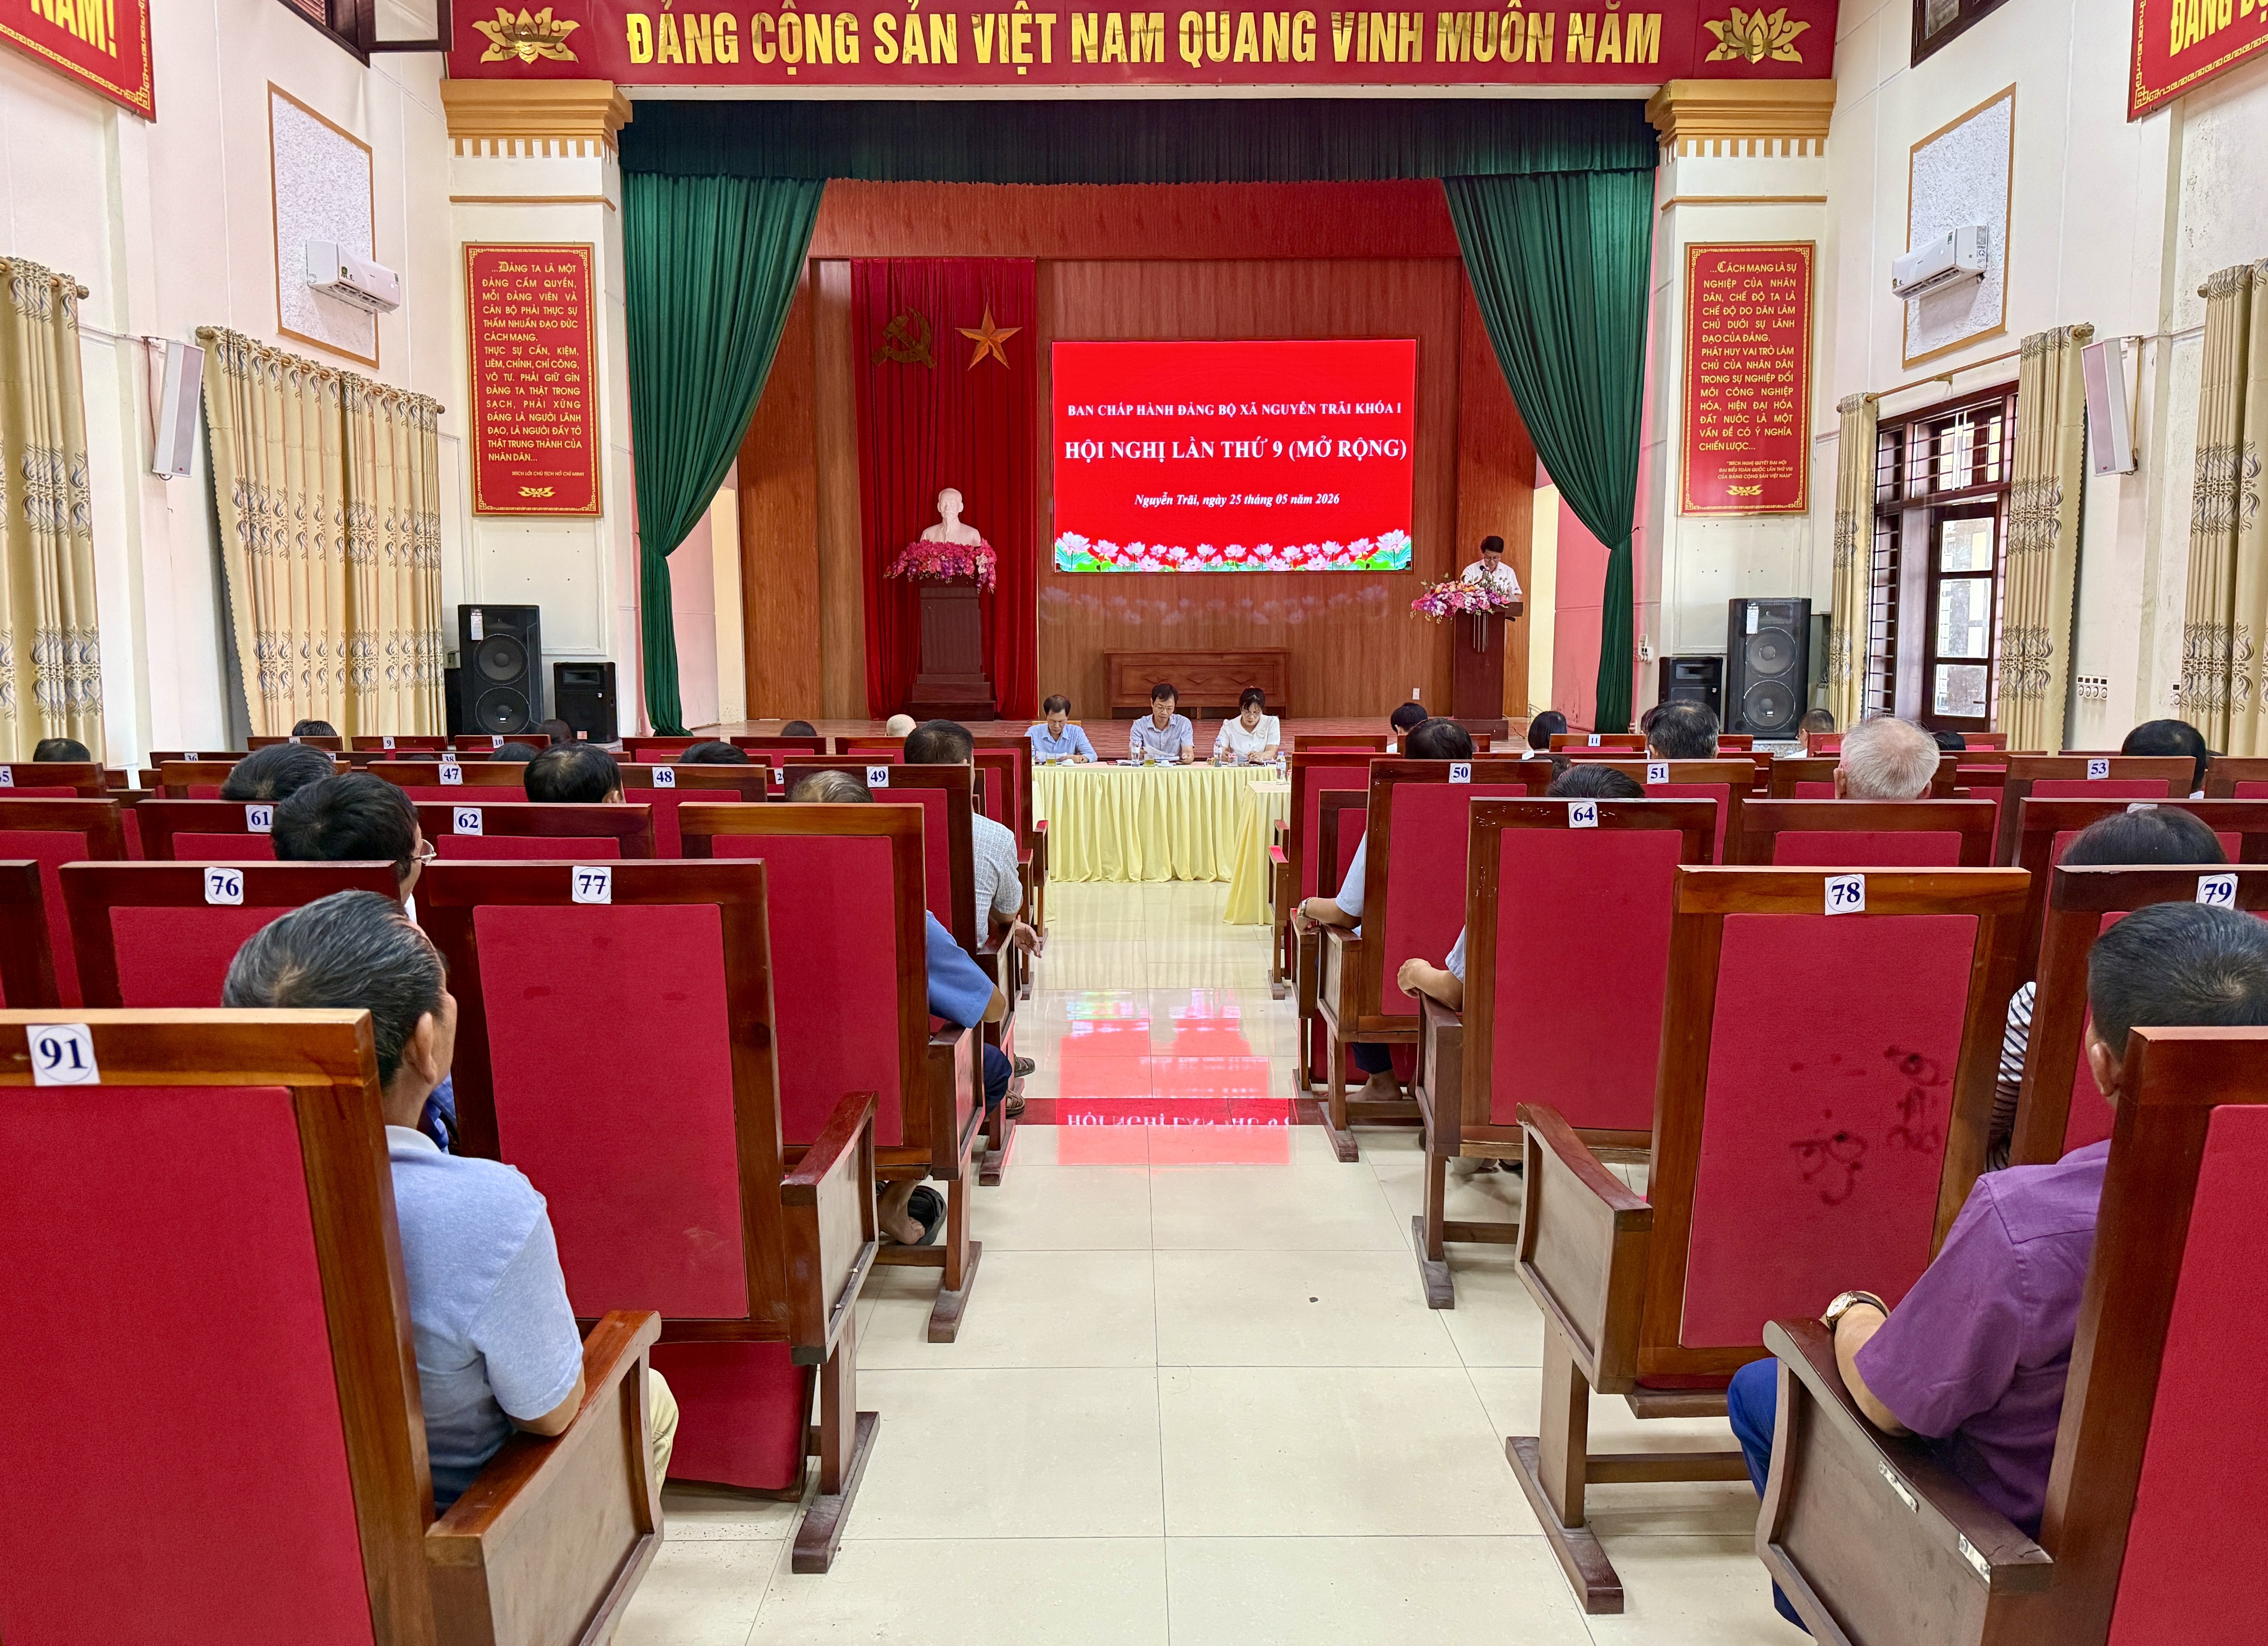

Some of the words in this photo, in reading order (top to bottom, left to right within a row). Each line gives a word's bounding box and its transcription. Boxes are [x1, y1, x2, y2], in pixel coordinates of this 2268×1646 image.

[752, 0, 859, 75] CỘNG
[874, 0, 957, 64] SẢN
[971, 0, 1056, 75] VIỆT
[1072, 13, 1164, 63] NAM
[1179, 11, 1316, 68] QUANG
[1331, 12, 1423, 62] VINH
[1436, 0, 1555, 62] MUÔN
[1566, 0, 1661, 63] NĂM
[531, 265, 541, 273] TA
[545, 262, 555, 273] LÀ
[558, 263, 576, 275] MỘT
[1747, 264, 1774, 273] MẠNG
[1775, 261, 1785, 272] LÀ
[1786, 263, 1797, 273] SỰ
[1704, 278, 1737, 290] NGHIỆP
[1743, 277, 1763, 288] CỦA
[1770, 277, 1796, 287] NHÂN
[506, 290, 532, 301] ĐẢNG
[538, 291, 558, 301] VIÊN
[564, 291, 577, 301] VÀ
[1703, 292, 1724, 303] DÂN,
[1729, 290, 1747, 301] CHẾ
[1751, 291, 1765, 303] ĐỘ
[1786, 290, 1796, 301] LÀ
[483, 303, 501, 314] CÁN
[505, 304, 517, 316] BỘ
[521, 304, 539, 314] PHẢI
[543, 306, 564, 316] THỰC
[568, 306, 577, 316] SỰ
[1702, 304, 1721, 316] CHẾ
[1723, 305, 1736, 317] ĐỘ
[1739, 307, 1753, 315] DO
[1756, 305, 1774, 314] DÂN
[1778, 304, 1795, 314] LÀM
[1702, 318, 1720, 329] CHỦ
[1727, 318, 1749, 329] DƯỚI
[1755, 320, 1766, 330] SỰ
[1773, 318, 1795, 328] LÃNH
[484, 331, 508, 341] CÁCH
[509, 333, 538, 343] MẠNG.
[1702, 334, 1722, 344] ĐẠO
[1723, 331, 1741, 342] CỦA
[1742, 331, 1770, 342] ĐẢNG.
[484, 346, 506, 356] THỰC
[512, 346, 522, 356] SỰ
[557, 345, 579, 357] KIỆM,
[1702, 346, 1723, 356] PHÁT
[1724, 348, 1741, 356] HUY
[1742, 347, 1757, 355] VAI
[1759, 345, 1775, 355] TRÒ
[1777, 345, 1794, 355] LÀM
[485, 358, 505, 369] LIÊM,
[506, 358, 534, 369] CHÍNH,
[535, 358, 550, 368] CHÍ
[551, 359, 579, 370] CÔNG,
[1701, 359, 1719, 370] CHỦ
[1723, 359, 1742, 370] CỦA
[1746, 359, 1771, 369] NHÂN
[1775, 359, 1794, 368] DÂN
[485, 371, 498, 381] VÔ
[521, 371, 538, 381] PHẢI
[564, 372, 580, 382] GÌN
[1701, 375, 1730, 383] TRONG
[1732, 374, 1743, 385] SỰ
[1745, 372, 1775, 384] NGHIỆP
[486, 384, 511, 395] ĐẢNG
[515, 387, 525, 395] TA
[529, 385, 548, 396] THẬT
[552, 387, 581, 395] TRONG
[1700, 387, 1718, 397] MỚI
[1725, 387, 1754, 396] CÔNG
[1761, 385, 1794, 397] NGHIỆP
[487, 400, 515, 409] SẠCH,
[523, 398, 545, 408] PHẢI
[553, 398, 581, 409] XỨNG
[1068, 405, 1093, 416] BAN
[1137, 402, 1173, 415] HÀNH
[1178, 402, 1214, 415] ĐẢNG
[1219, 403, 1236, 417] BỘ
[1240, 402, 1258, 415] XÃ
[1355, 400, 1394, 414] KHÓA
[1397, 402, 1401, 413] I
[1700, 400, 1721, 411] HÓA,
[1728, 400, 1747, 411] HIỆN
[1753, 401, 1768, 411] ĐẠI
[1774, 398, 1793, 409] HÓA
[487, 411, 512, 421] ĐÁNG
[515, 411, 526, 421] LÀ
[529, 411, 556, 422] NGƯỜI
[560, 412, 581, 422] LÃNH
[1699, 413, 1717, 424] ĐẤT
[1723, 413, 1749, 424] NƯỚC
[1757, 413, 1767, 423] LÀ
[1774, 413, 1793, 424] MỘT
[487, 438, 506, 450] THẬT
[508, 440, 534, 448] TRUNG
[535, 438, 562, 448] THÀNH
[564, 438, 582, 449] CỦA
[1065, 439, 1104, 463] HỘI
[1111, 441, 1165, 463] NGHỊ
[1221, 436, 1268, 458] THỨ
[1273, 441, 1283, 458] 9
[1289, 435, 1332, 462] (MỞ
[1338, 437, 1406, 461] RỘNG)
[1726, 442, 1755, 452] LƯỢC...
[488, 452, 512, 461] NHÂN
[513, 452, 537, 461] DÂN...
[1177, 494, 1200, 506] Trãi,
[1202, 494, 1227, 508] ngày
[1229, 494, 1242, 505] 25
[1244, 494, 1273, 507] tháng
[1275, 494, 1288, 504] 05
[1290, 494, 1313, 504] năm
[1315, 493, 1340, 504] 2026
[444, 768, 459, 780] 47
[1453, 767, 1468, 778] 50
[1650, 767, 1665, 779] 51
[2091, 762, 2106, 775] 53
[0, 770, 9, 782] 5
[656, 771, 672, 782] 48
[870, 770, 886, 782] 49
[251, 811, 271, 826] 61
[458, 813, 478, 828] 62
[1573, 807, 1594, 822] 64
[211, 876, 239, 896] 76
[579, 874, 606, 895] 77
[1831, 882, 1860, 905] 78
[2203, 883, 2231, 904] 79
[40, 1038, 88, 1069] 91
